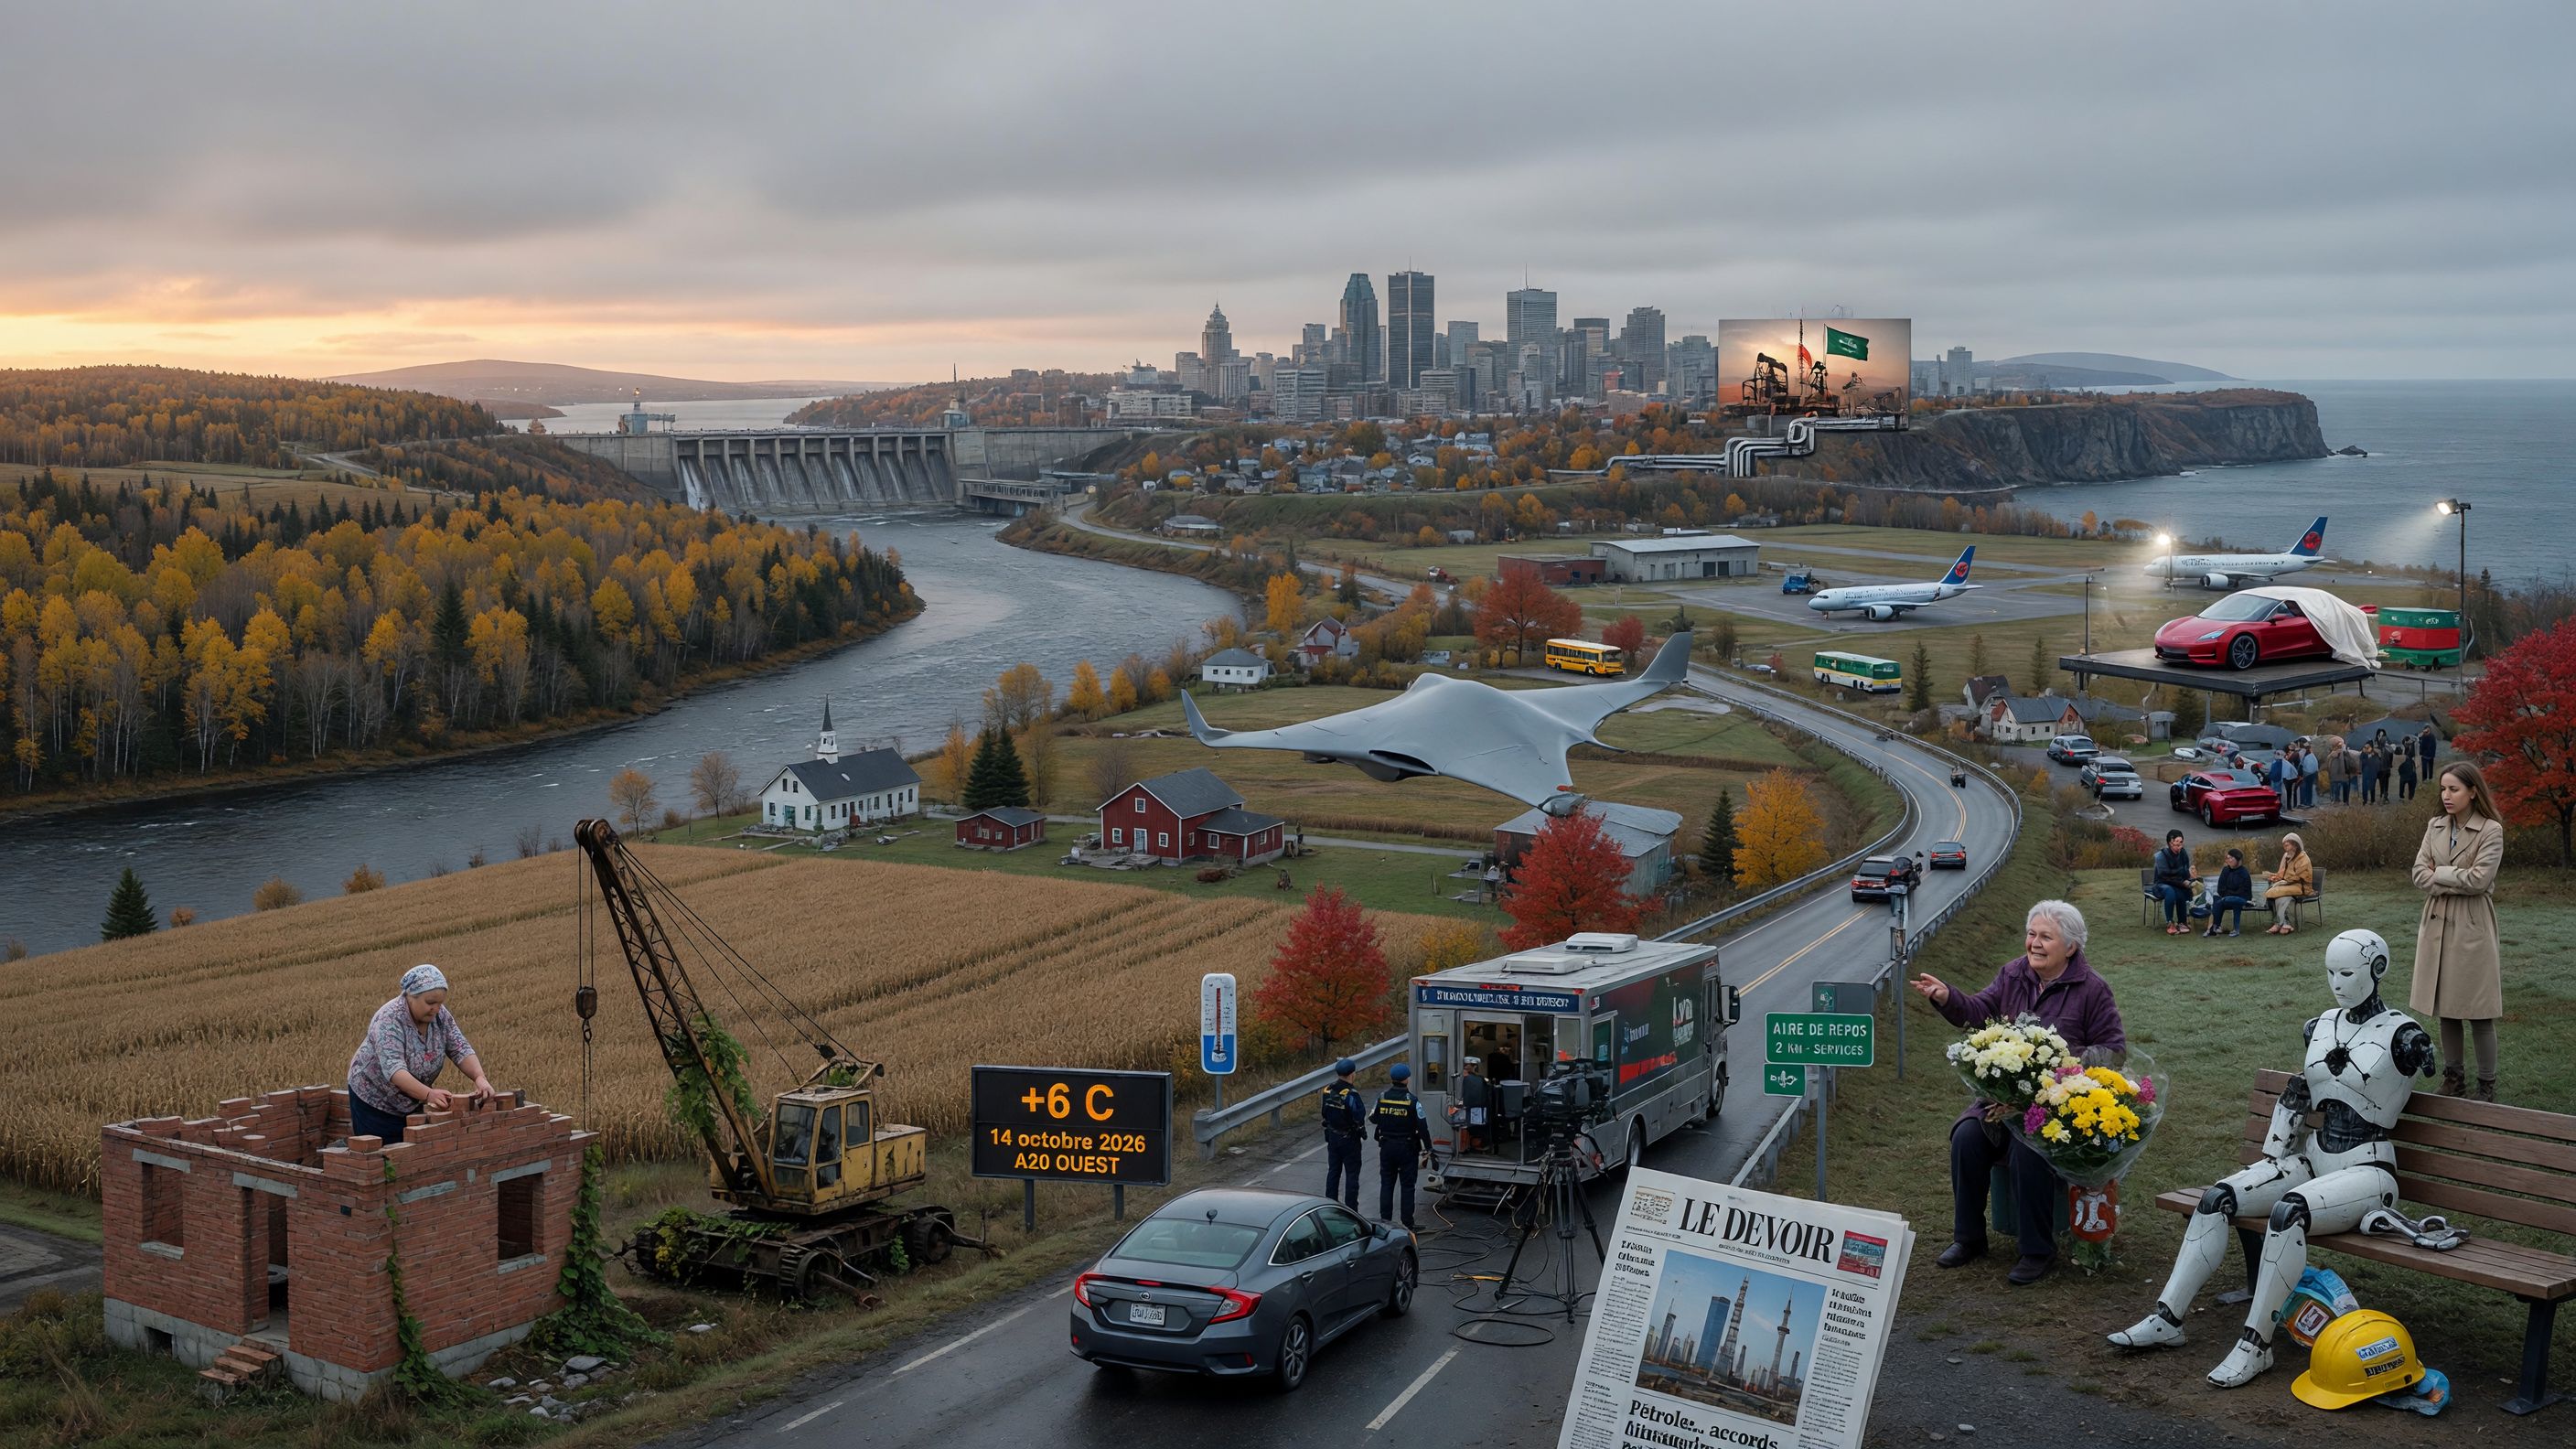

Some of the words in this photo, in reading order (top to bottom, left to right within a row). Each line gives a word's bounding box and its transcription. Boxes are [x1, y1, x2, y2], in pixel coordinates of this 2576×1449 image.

[1773, 1022, 1804, 1036] AIRE
[1809, 1023, 1824, 1036] DE
[1829, 1024, 1867, 1036] REPOS
[1776, 1041, 1783, 1054] 2
[1813, 1044, 1863, 1056] SERVICES
[1021, 1082, 1071, 1120] +6
[1085, 1084, 1114, 1122] C
[991, 1128, 1013, 1146] 14
[1017, 1131, 1093, 1151] octobre
[1099, 1132, 1146, 1154] 2026
[1014, 1152, 1050, 1171] A20
[1056, 1154, 1121, 1175] OUEST
[1678, 1197, 1721, 1238] LE
[1722, 1207, 1836, 1264] DEVOIR
[1709, 1425, 1779, 1449] accords
